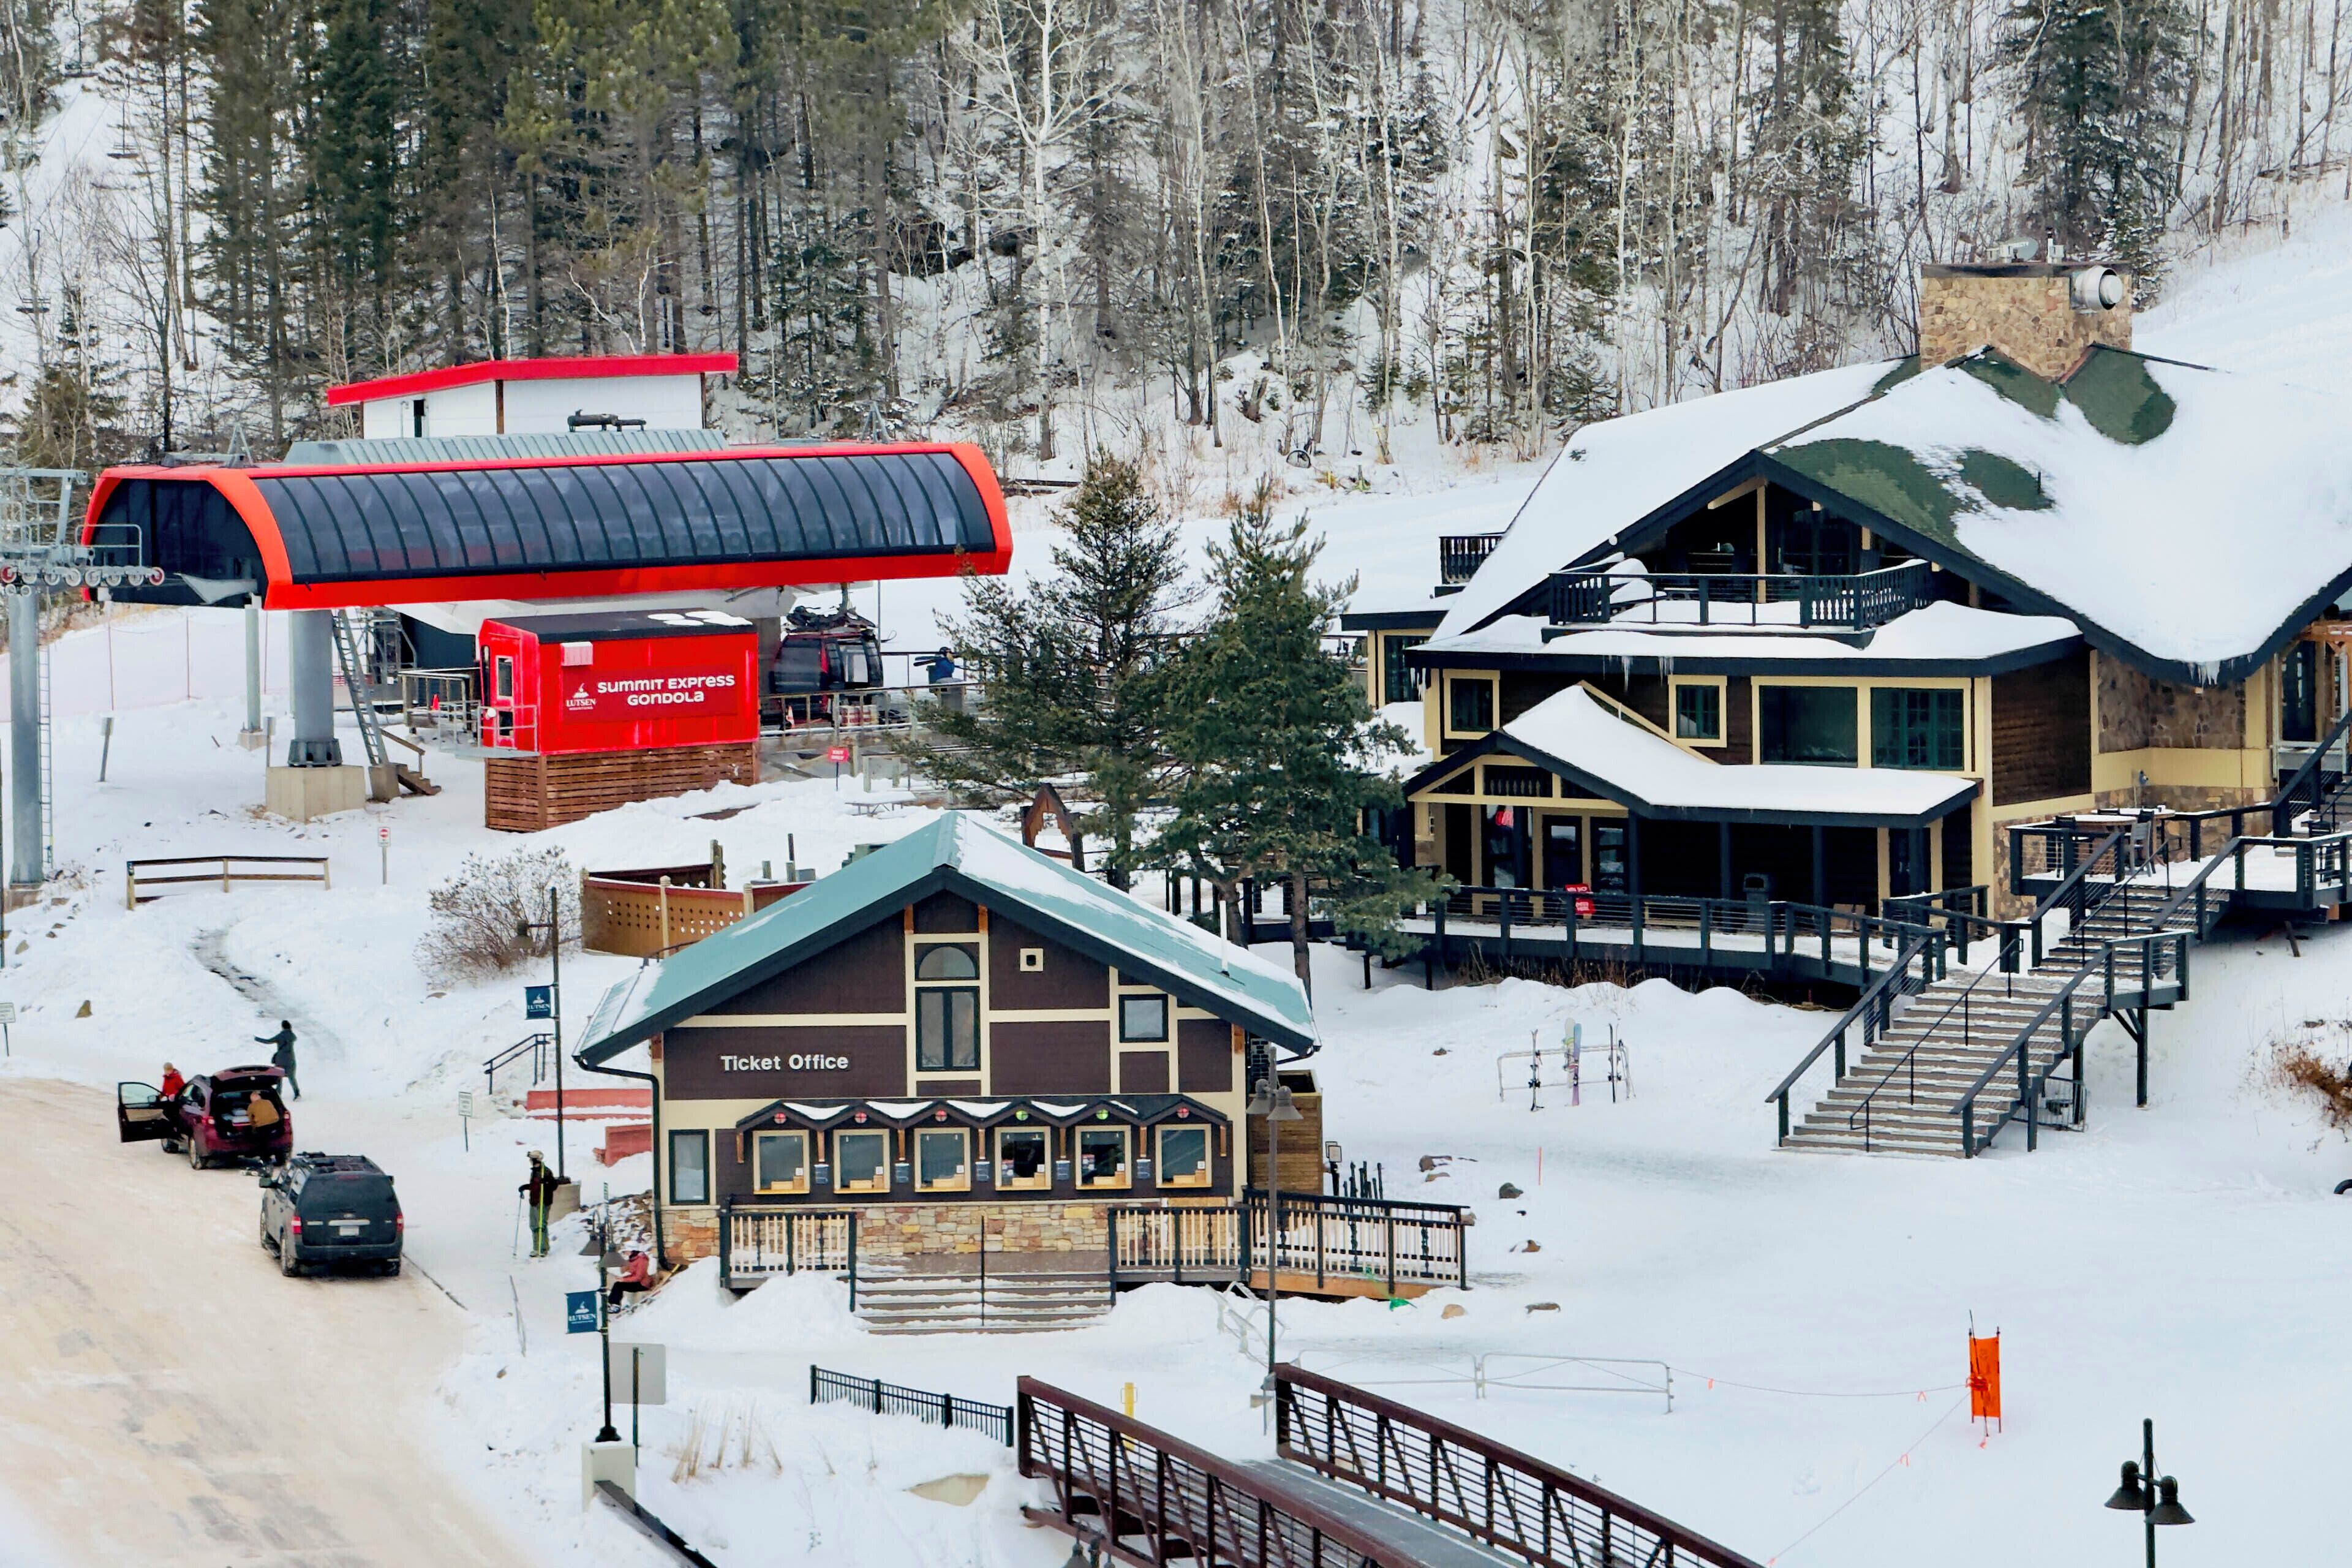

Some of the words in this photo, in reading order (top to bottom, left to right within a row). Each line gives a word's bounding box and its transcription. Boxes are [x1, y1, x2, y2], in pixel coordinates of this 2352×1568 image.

[566, 698, 597, 707] LUTSEN
[721, 1055, 781, 1071] Ticket
[788, 1054, 848, 1069] Office
